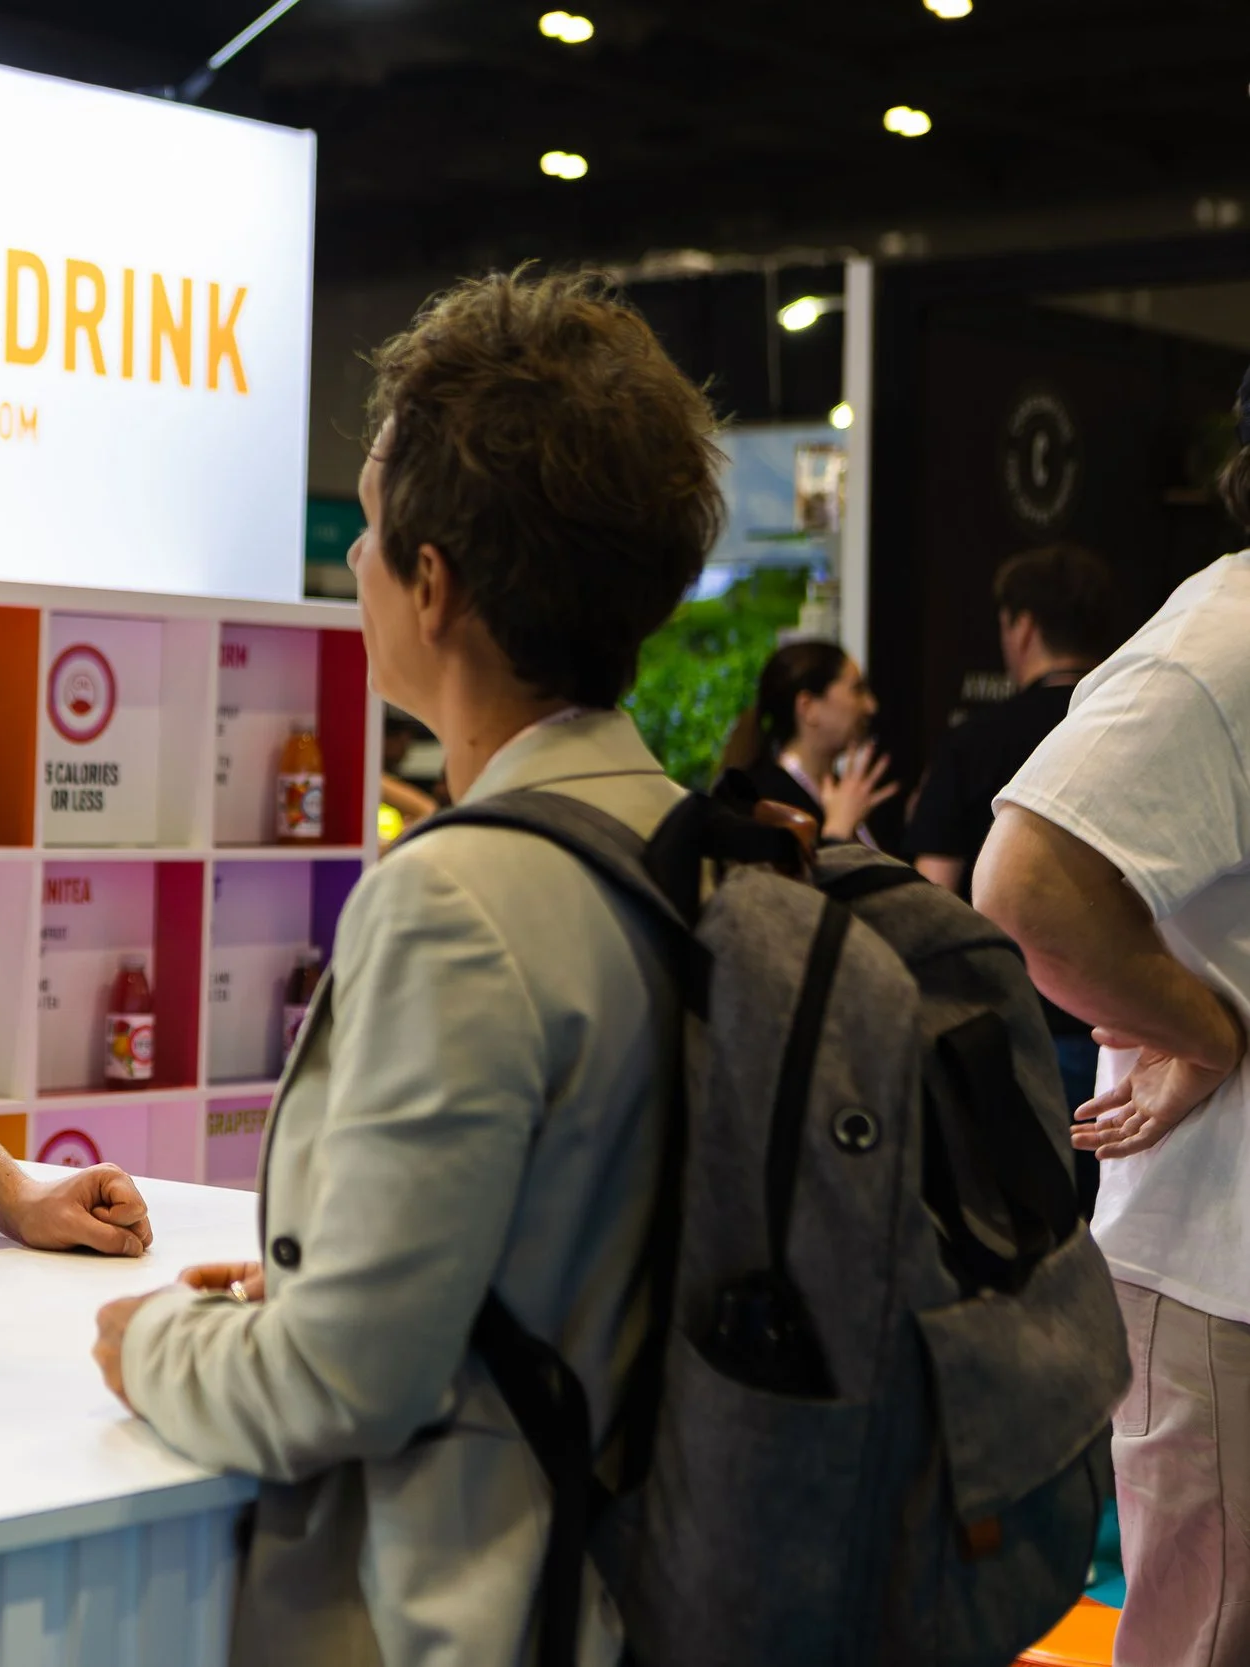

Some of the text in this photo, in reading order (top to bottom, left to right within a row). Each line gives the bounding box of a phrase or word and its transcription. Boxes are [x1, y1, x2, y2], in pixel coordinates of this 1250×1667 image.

[4, 247, 249, 394] DRINK
[55, 762, 120, 787] CALORIES
[51, 788, 104, 813] OR LESS
